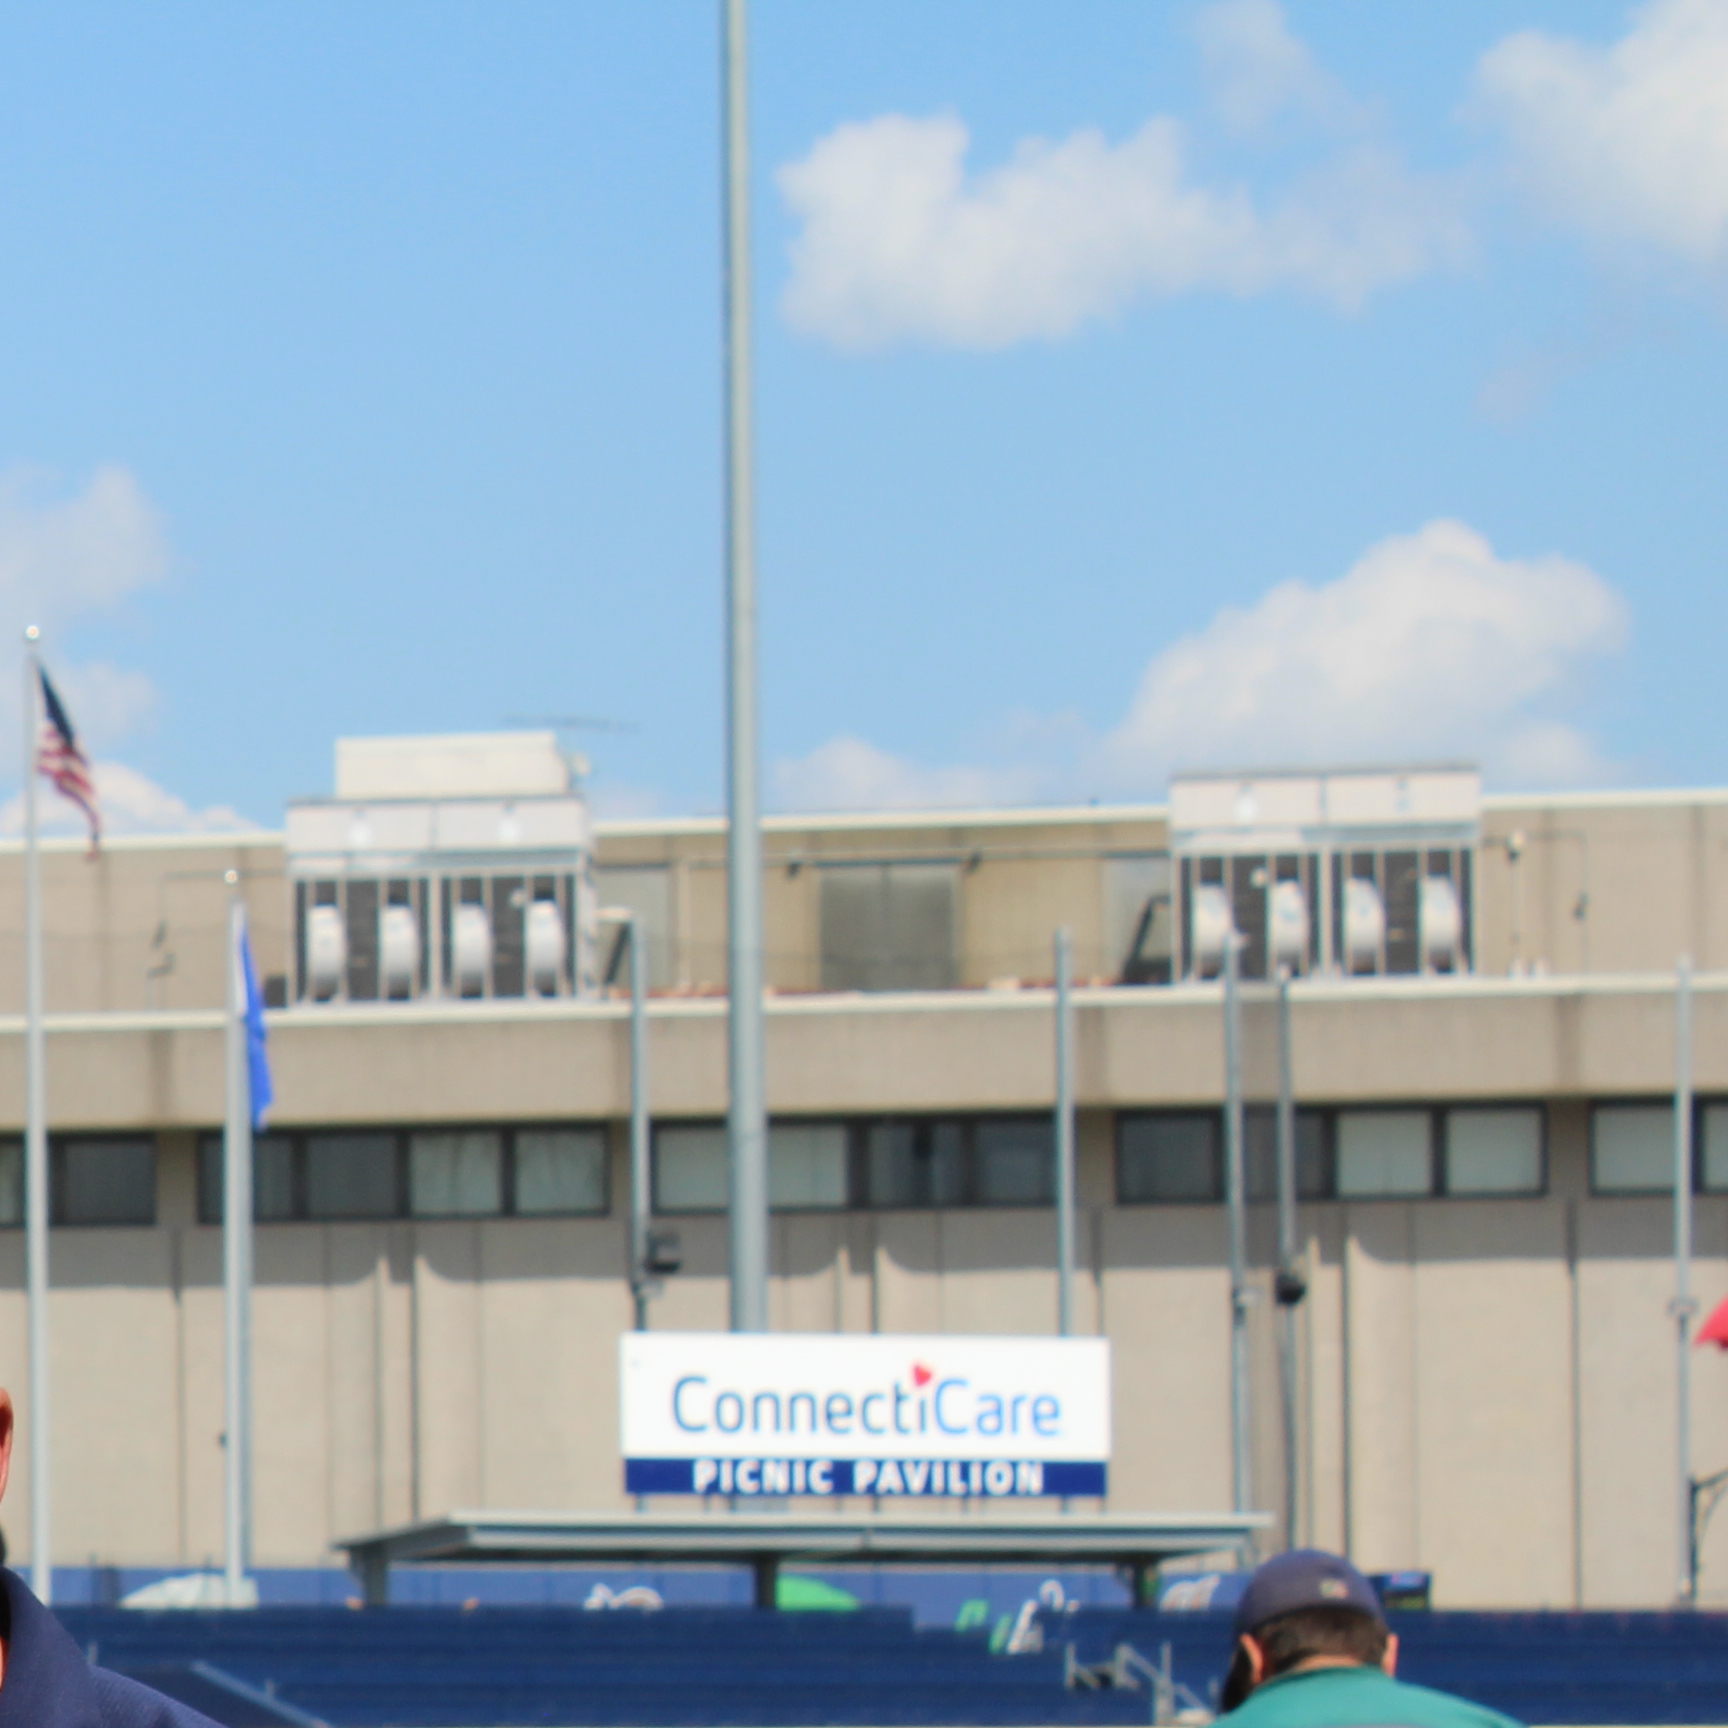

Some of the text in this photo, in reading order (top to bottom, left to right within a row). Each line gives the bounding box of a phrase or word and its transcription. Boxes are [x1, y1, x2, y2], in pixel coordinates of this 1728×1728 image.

[671, 1374, 1061, 1437] ConnectiCare
[692, 1458, 1043, 1495] PICNIC PAVILION
